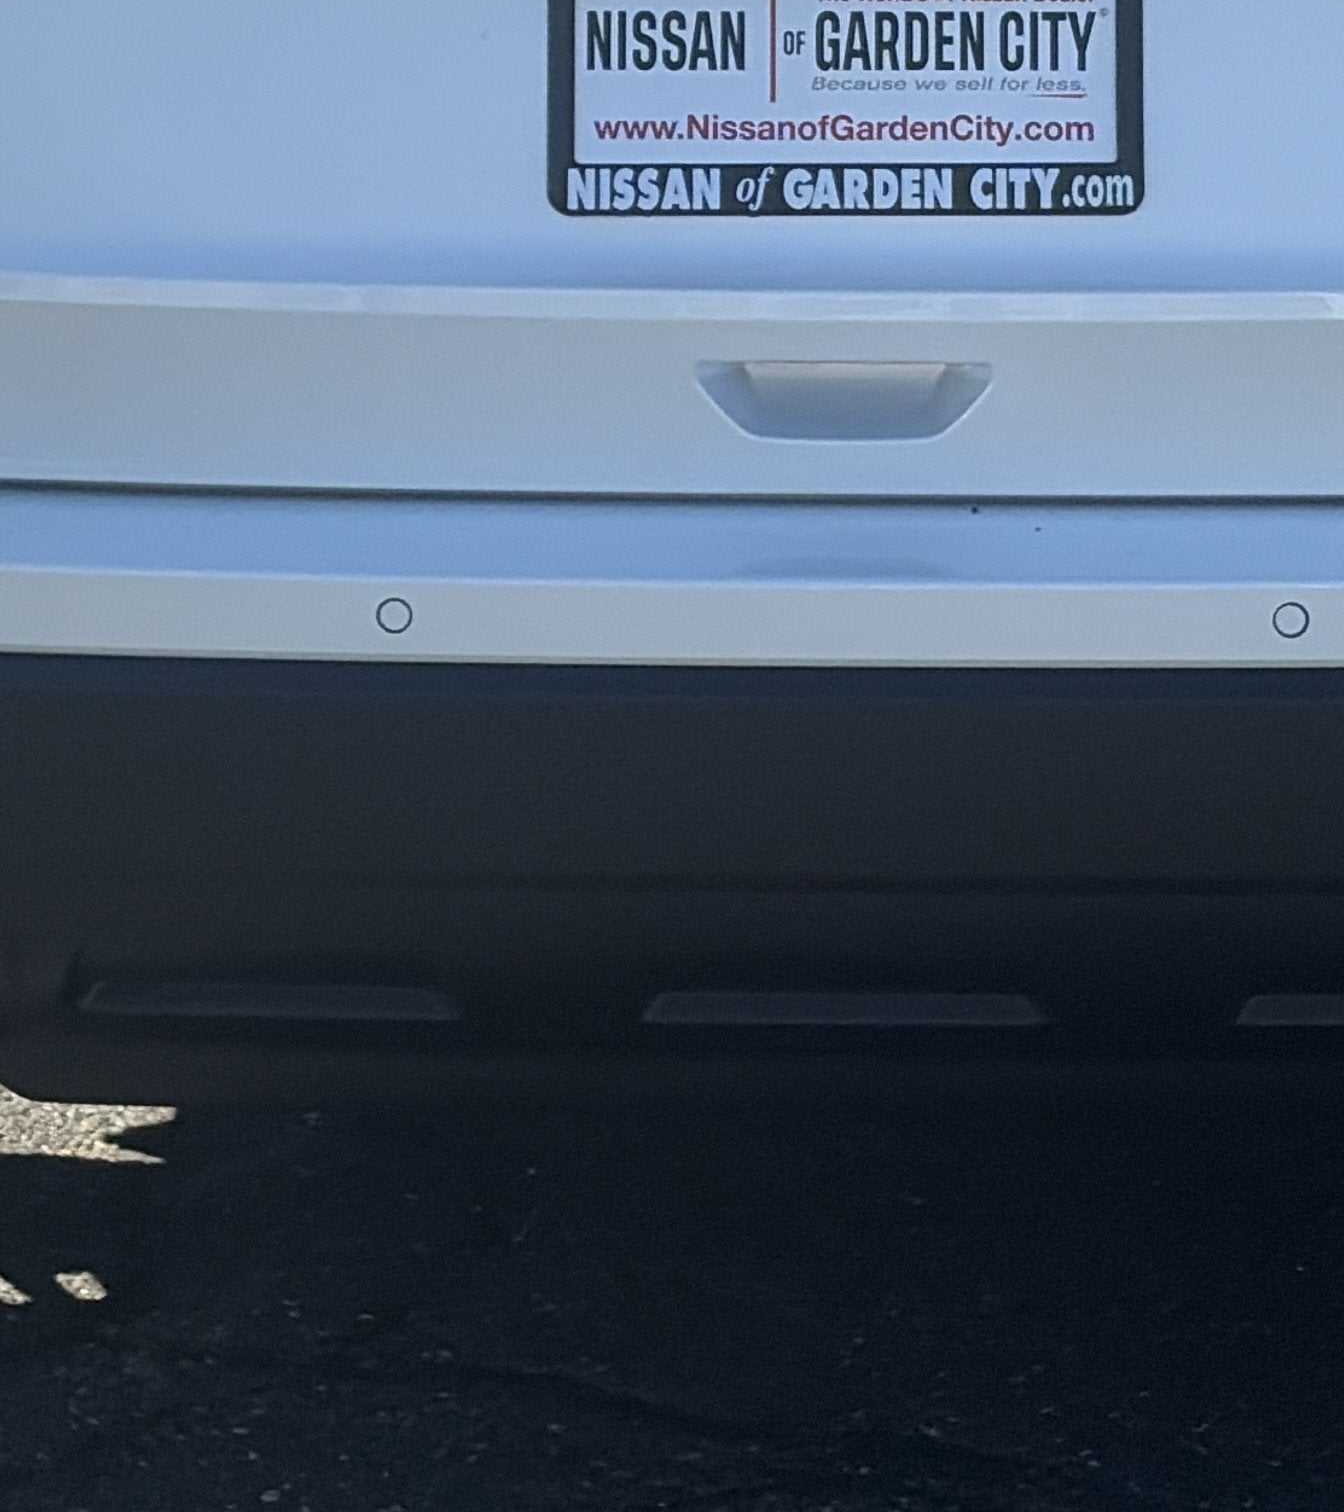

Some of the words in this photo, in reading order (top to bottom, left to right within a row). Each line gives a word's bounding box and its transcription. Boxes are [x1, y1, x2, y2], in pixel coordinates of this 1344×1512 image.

[586, 10, 746, 72] NISSAN
[782, 30, 806, 56] OF
[814, 10, 985, 72] GARDEN
[999, 10, 1097, 72] CITY
[811, 76, 907, 91] Because
[914, 79, 948, 91] we
[955, 76, 993, 91] sell
[999, 76, 1029, 91] for
[1035, 76, 1087, 92] less.
[593, 114, 1095, 147] www.NissanofGardenCity.com
[566, 167, 722, 210] NISSAN
[735, 166, 776, 211] of
[783, 167, 954, 210] GARDEN
[969, 167, 1135, 211] CITY.com
